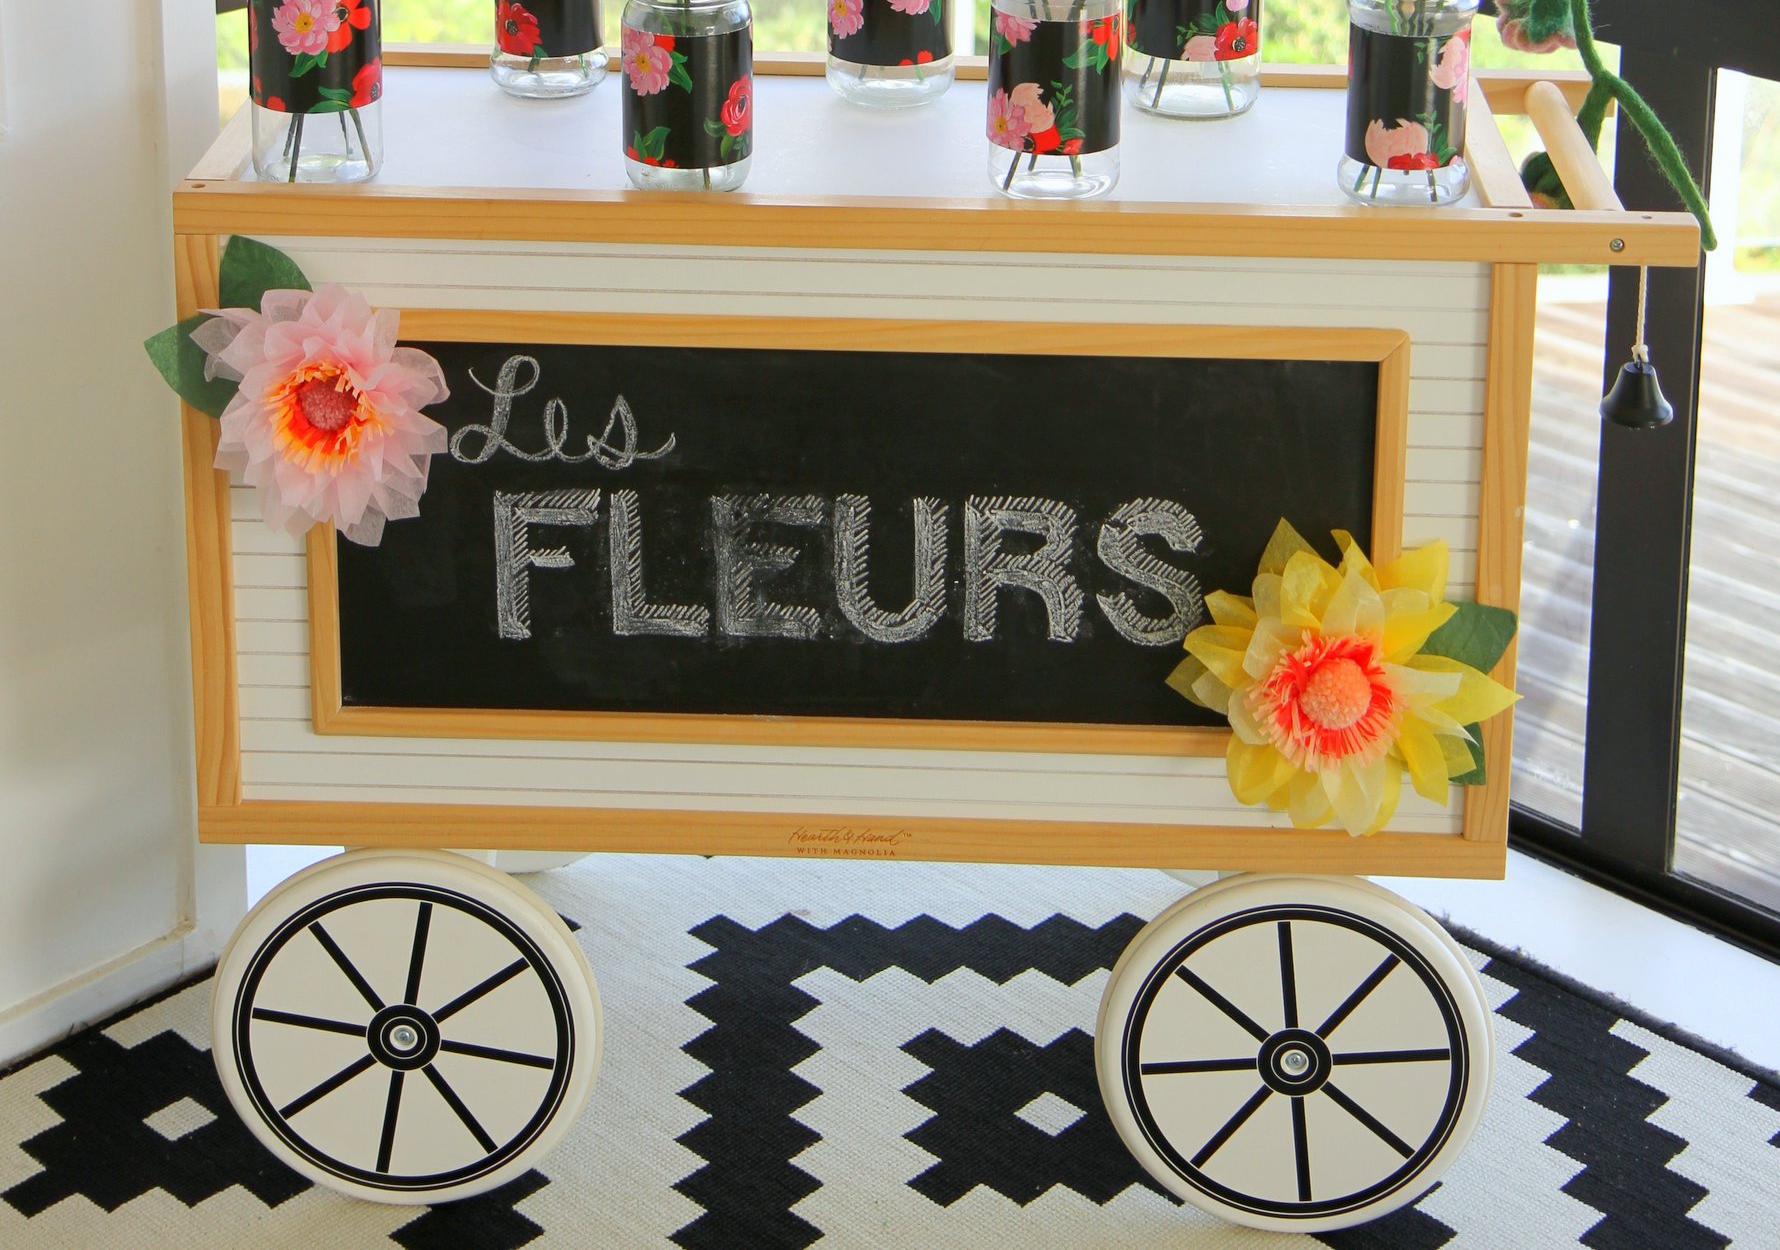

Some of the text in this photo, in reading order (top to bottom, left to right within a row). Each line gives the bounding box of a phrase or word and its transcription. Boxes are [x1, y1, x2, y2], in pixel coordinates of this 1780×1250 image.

[450, 354, 676, 470] Les
[493, 488, 1203, 647] FLEURS
[788, 826, 846, 844] Hearth
[843, 829, 854, 844] &
[796, 846, 896, 857] WITH MAGNOLIA
